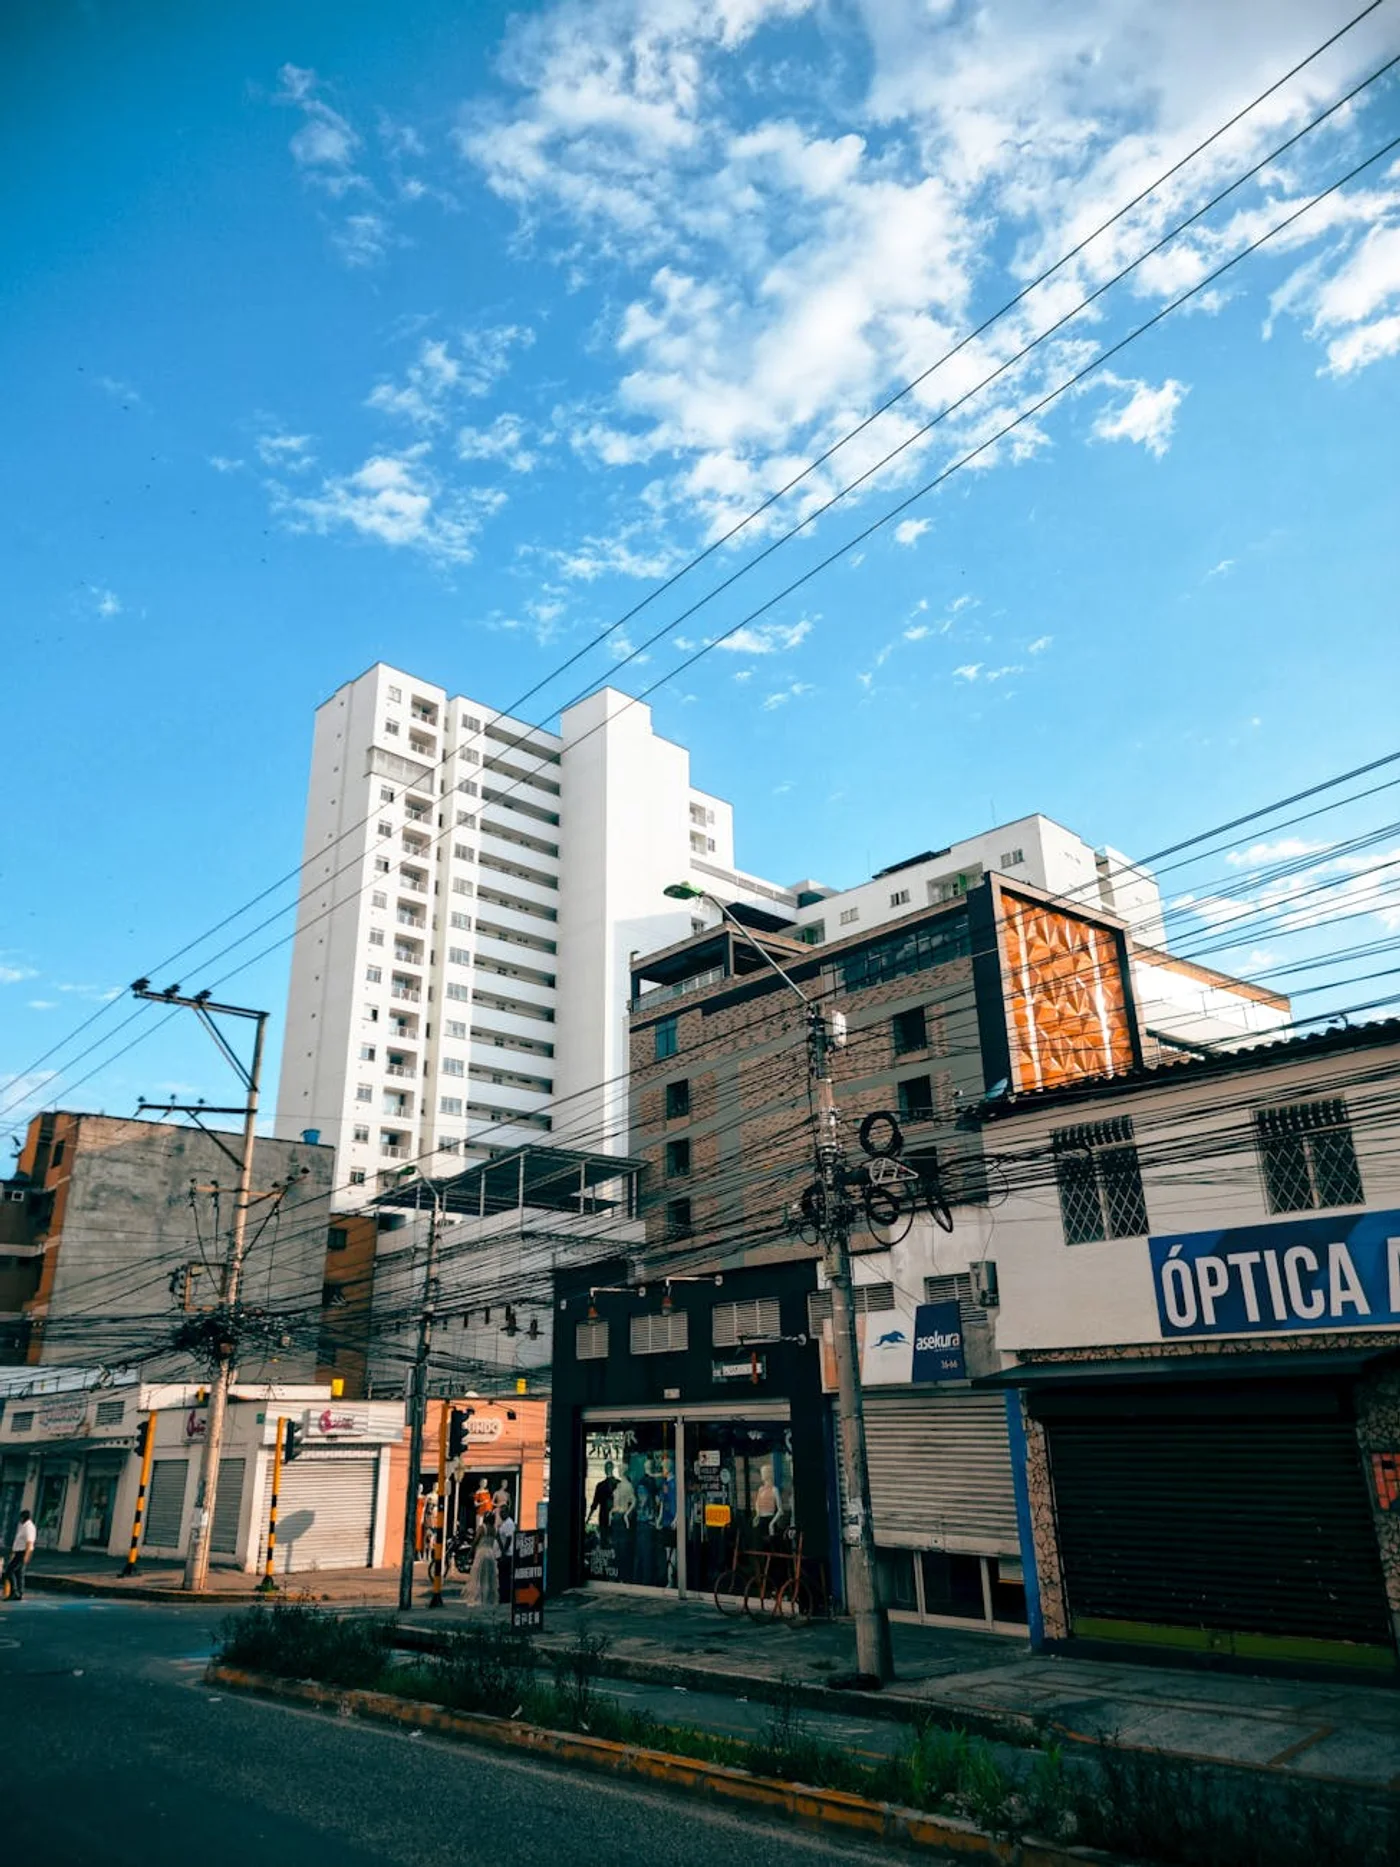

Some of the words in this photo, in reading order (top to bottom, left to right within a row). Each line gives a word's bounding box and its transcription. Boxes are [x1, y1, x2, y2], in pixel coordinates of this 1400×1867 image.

[1160, 1243, 1372, 1328] ÓPTICA
[916, 1330, 960, 1350] asekura
[514, 1611, 541, 1627] OPEN
